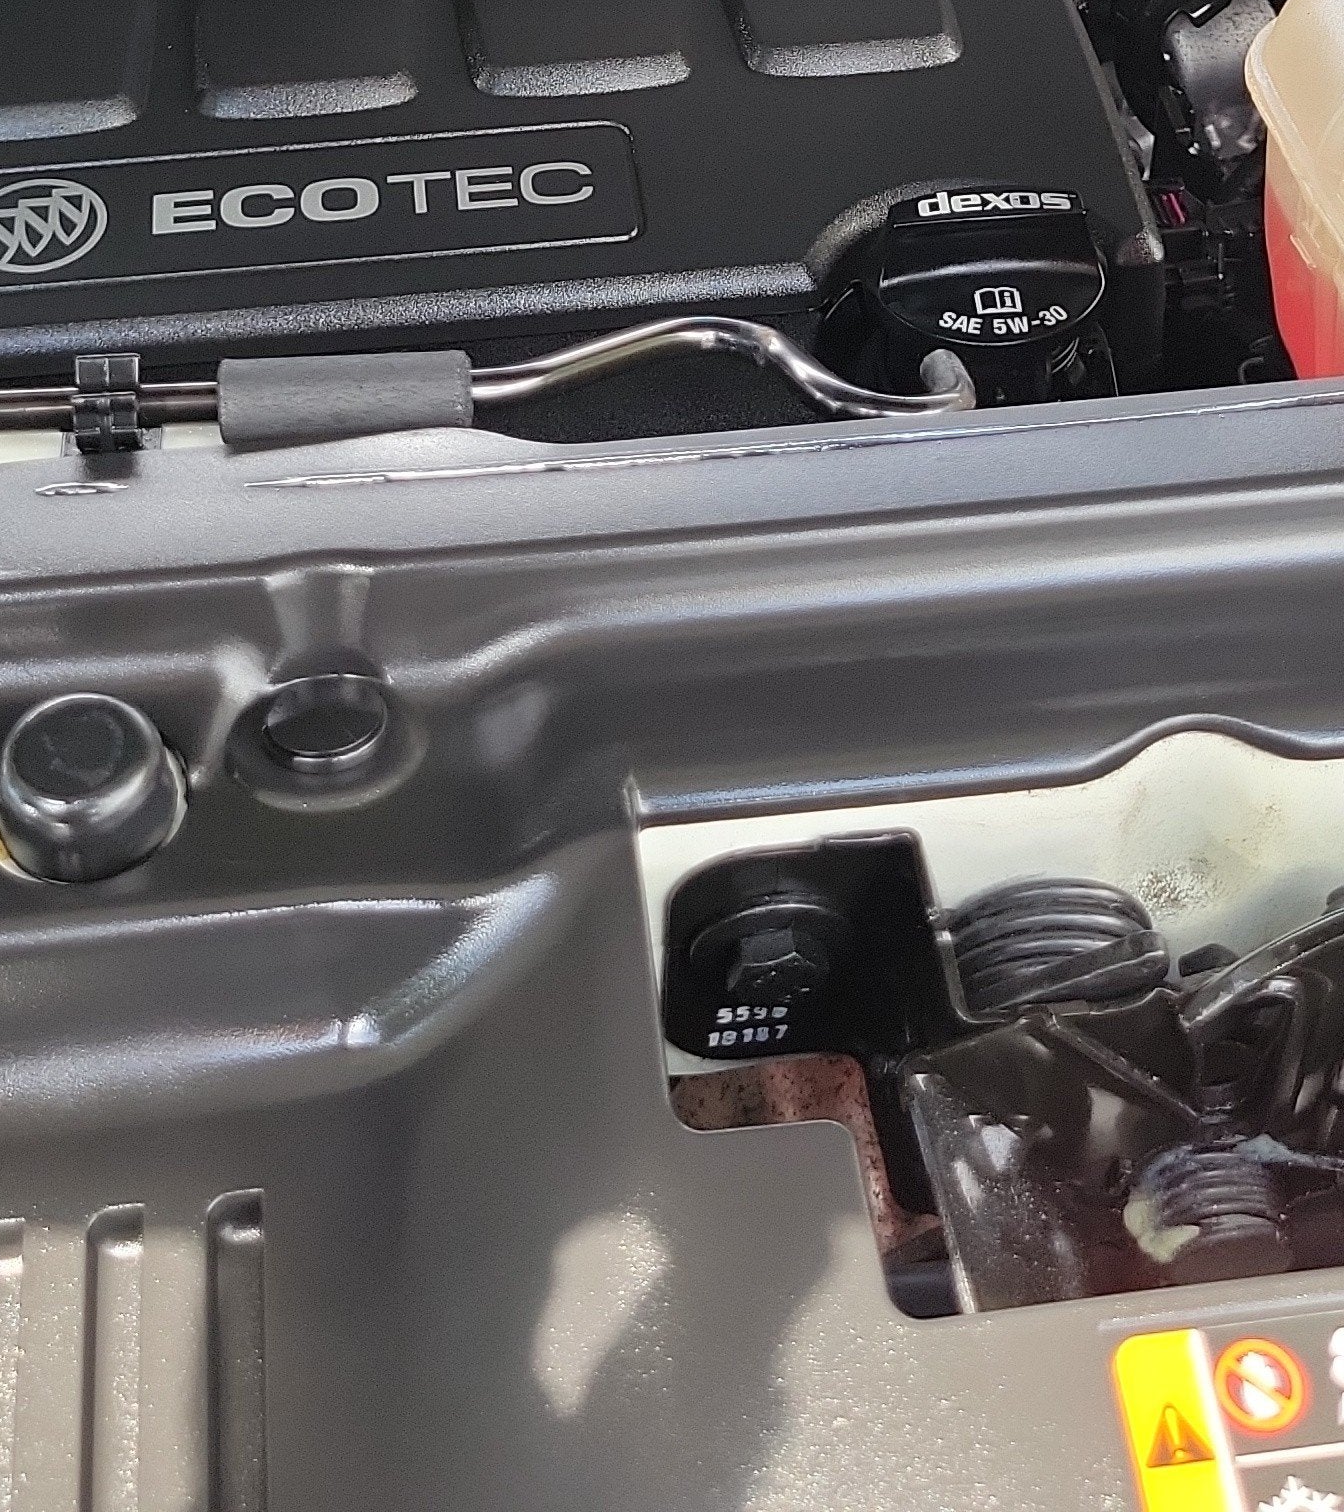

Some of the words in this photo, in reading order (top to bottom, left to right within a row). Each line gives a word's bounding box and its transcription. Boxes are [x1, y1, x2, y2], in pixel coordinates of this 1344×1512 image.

[151, 161, 594, 236] ECOTEC
[917, 191, 1072, 217] dexos
[938, 310, 984, 335] SAE
[992, 304, 1069, 335] 5W-30
